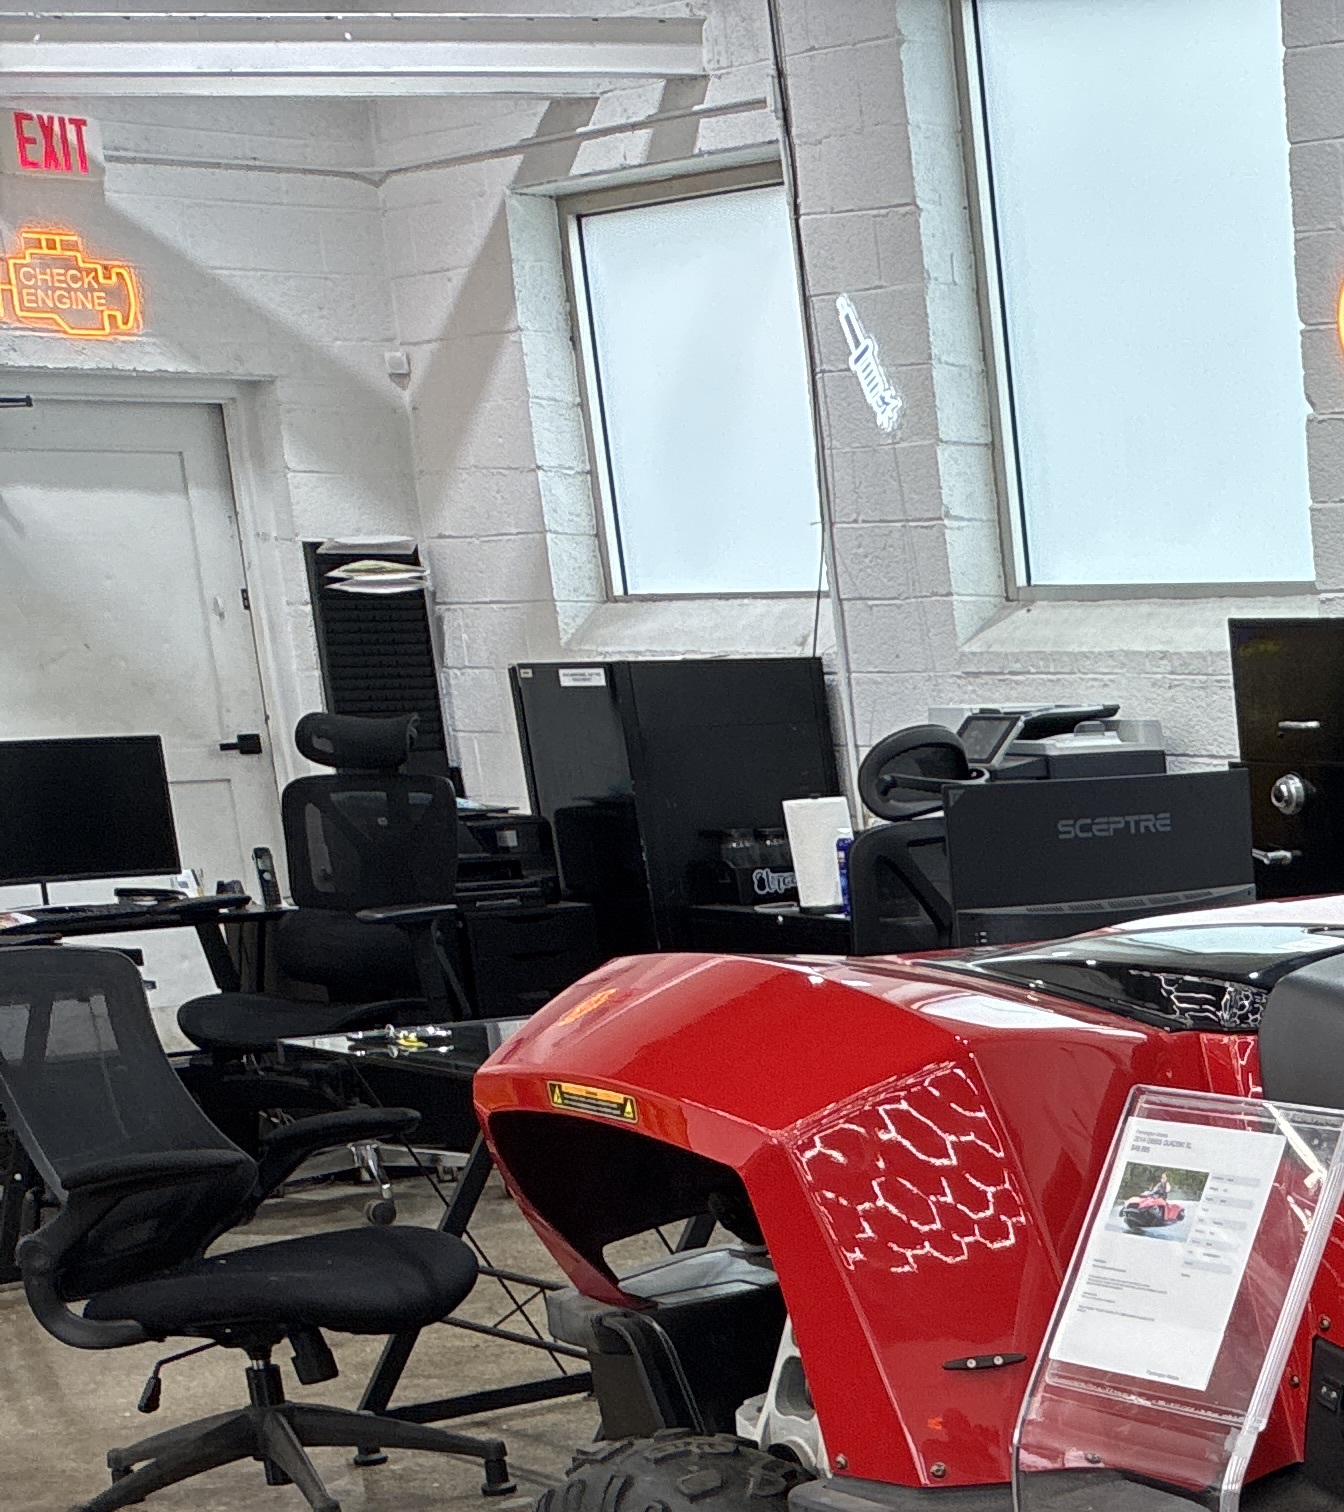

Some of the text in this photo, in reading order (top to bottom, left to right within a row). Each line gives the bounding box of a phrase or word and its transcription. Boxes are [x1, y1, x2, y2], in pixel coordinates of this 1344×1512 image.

[14, 112, 89, 174] EXIT
[20, 267, 99, 289] CHECK
[22, 288, 107, 311] ENGINE
[1057, 813, 1171, 839] SCEPTRE
